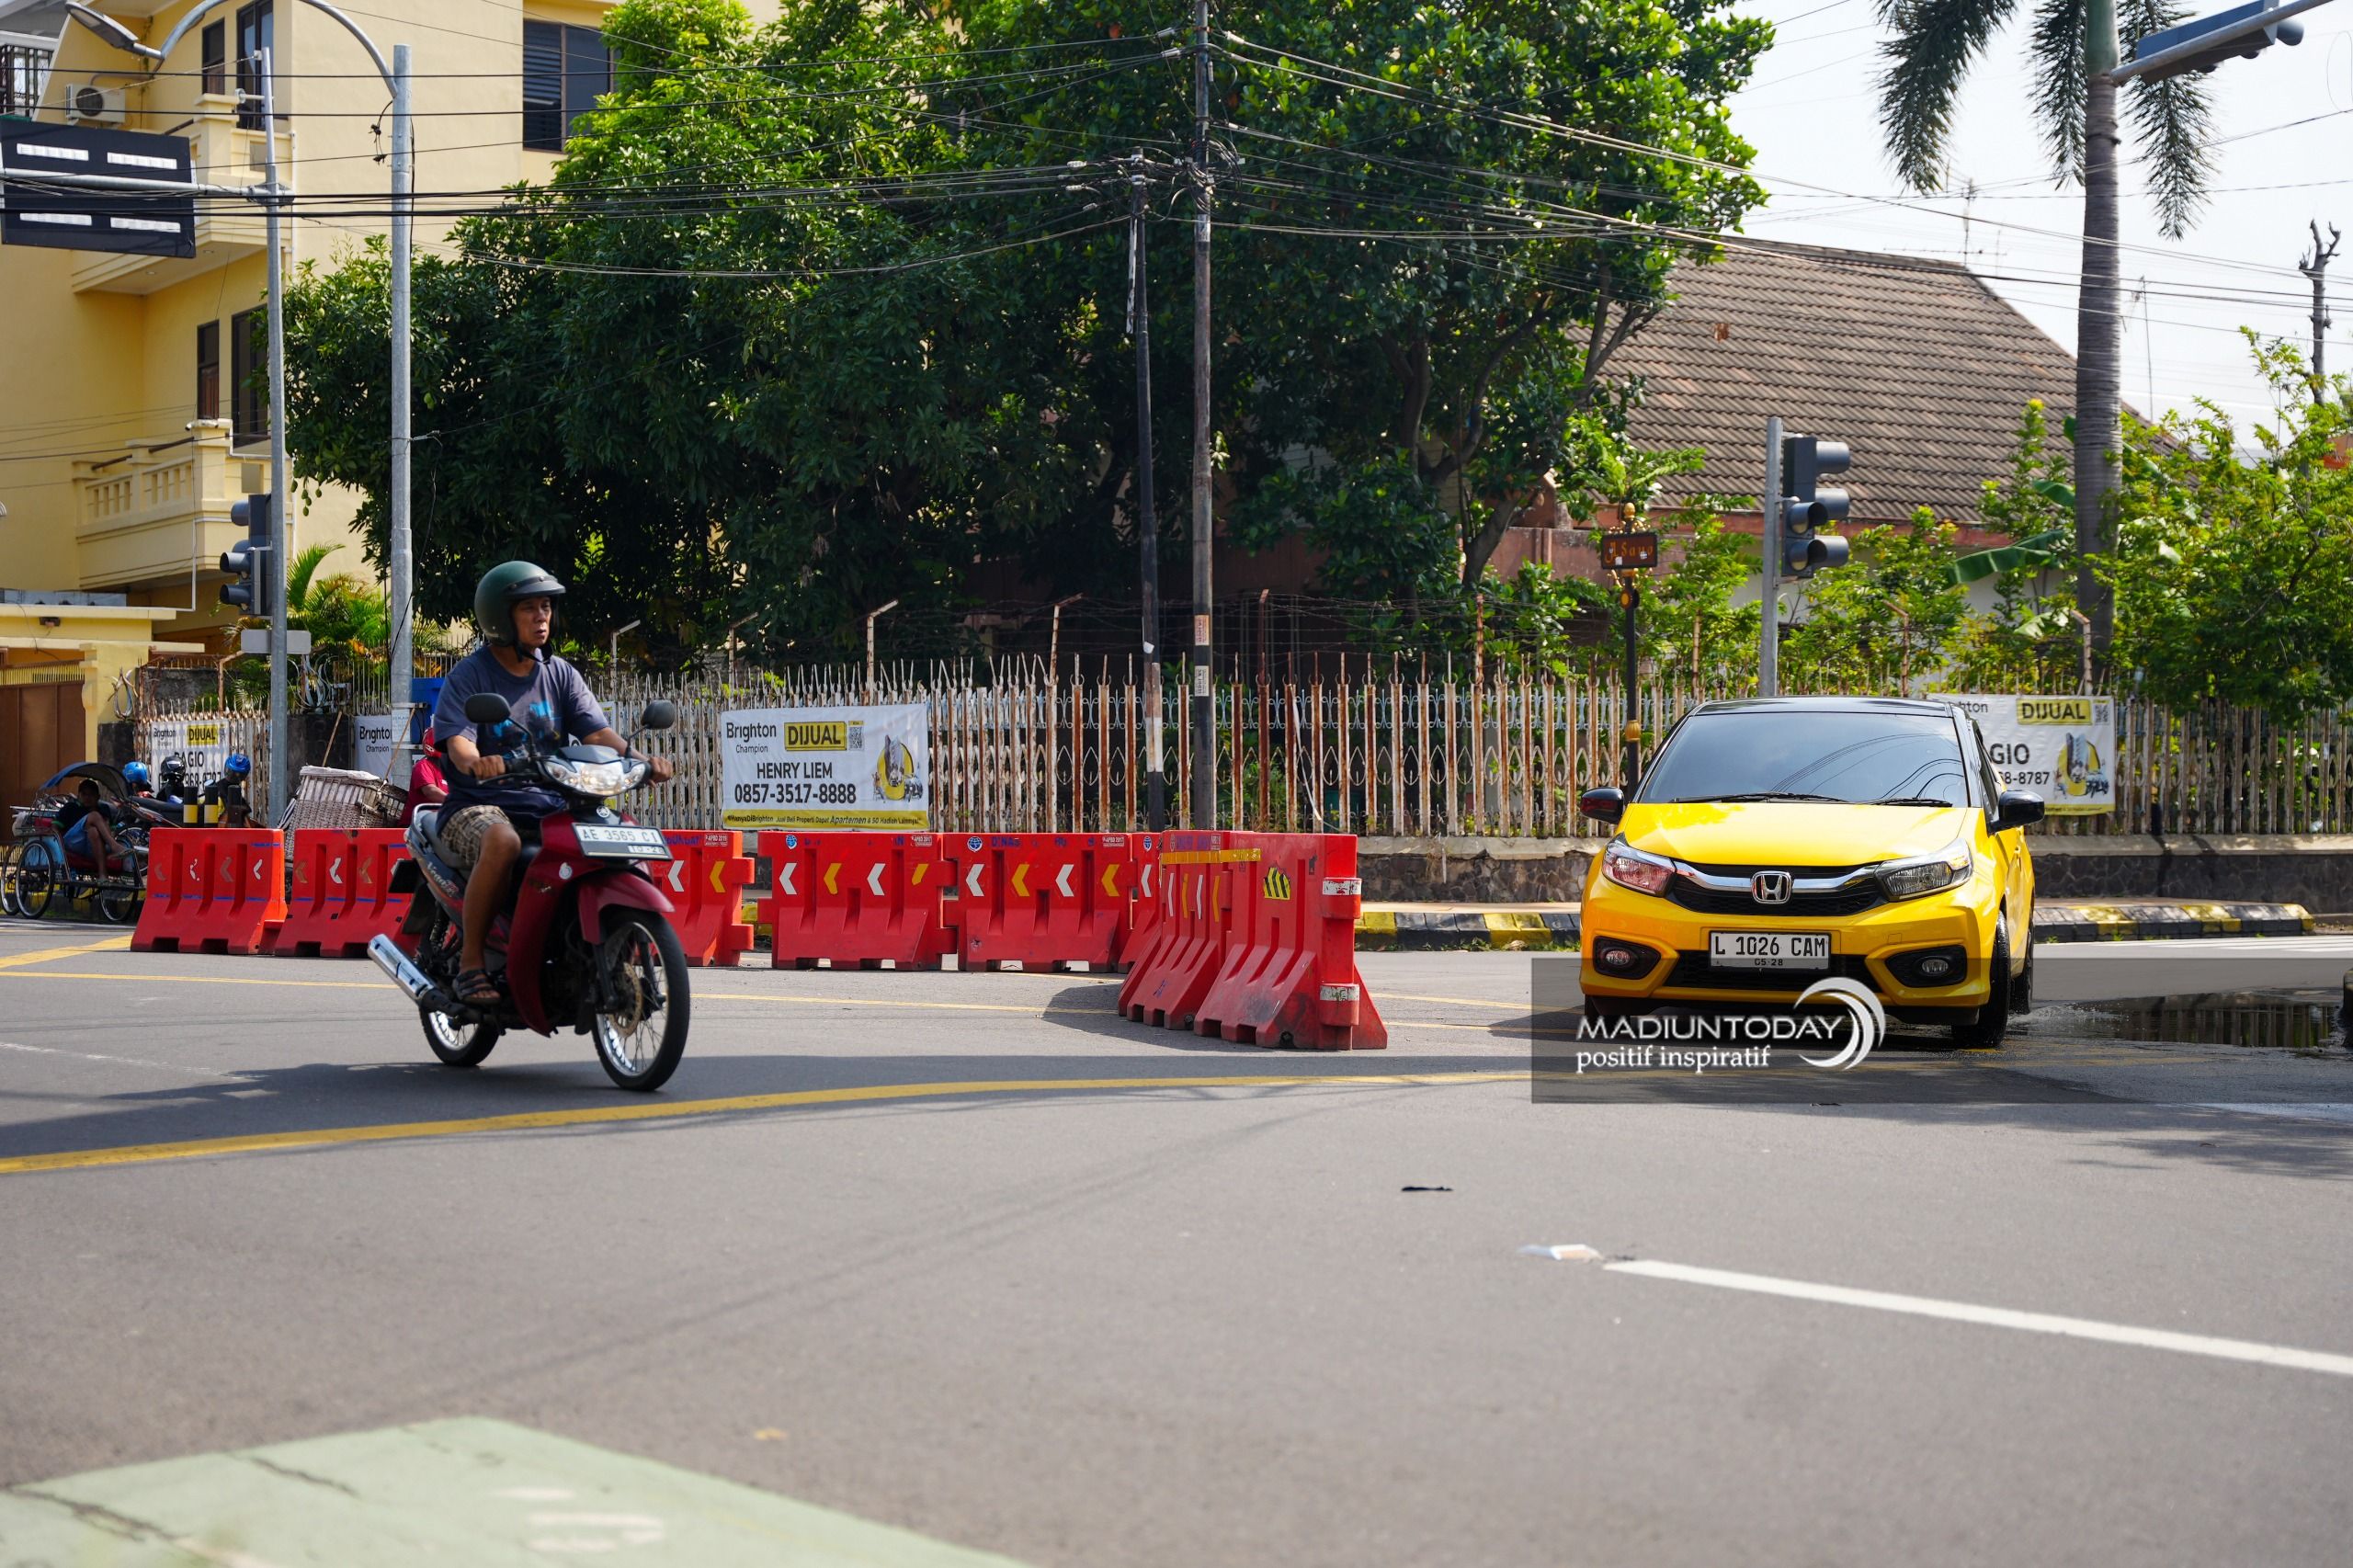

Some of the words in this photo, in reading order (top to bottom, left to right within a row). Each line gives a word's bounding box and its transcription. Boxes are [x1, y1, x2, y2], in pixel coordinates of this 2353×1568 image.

[2022, 702, 2086, 720] DIJUAL
[359, 726, 392, 744] Brighto
[726, 722, 777, 743] Brighton
[788, 725, 841, 745] DIJUAL
[735, 744, 768, 754] Champion
[1990, 743, 2029, 765] GIO
[756, 763, 800, 778] HENRY
[803, 762, 833, 778] LIEM
[734, 783, 857, 804] 0857-3517-8888
[830, 815, 867, 825] Apartemen
[583, 829, 599, 840] AE
[607, 830, 635, 842] 3565
[1715, 936, 1726, 955] L
[1735, 937, 1779, 956] 1026
[1790, 937, 1825, 957] CAM
